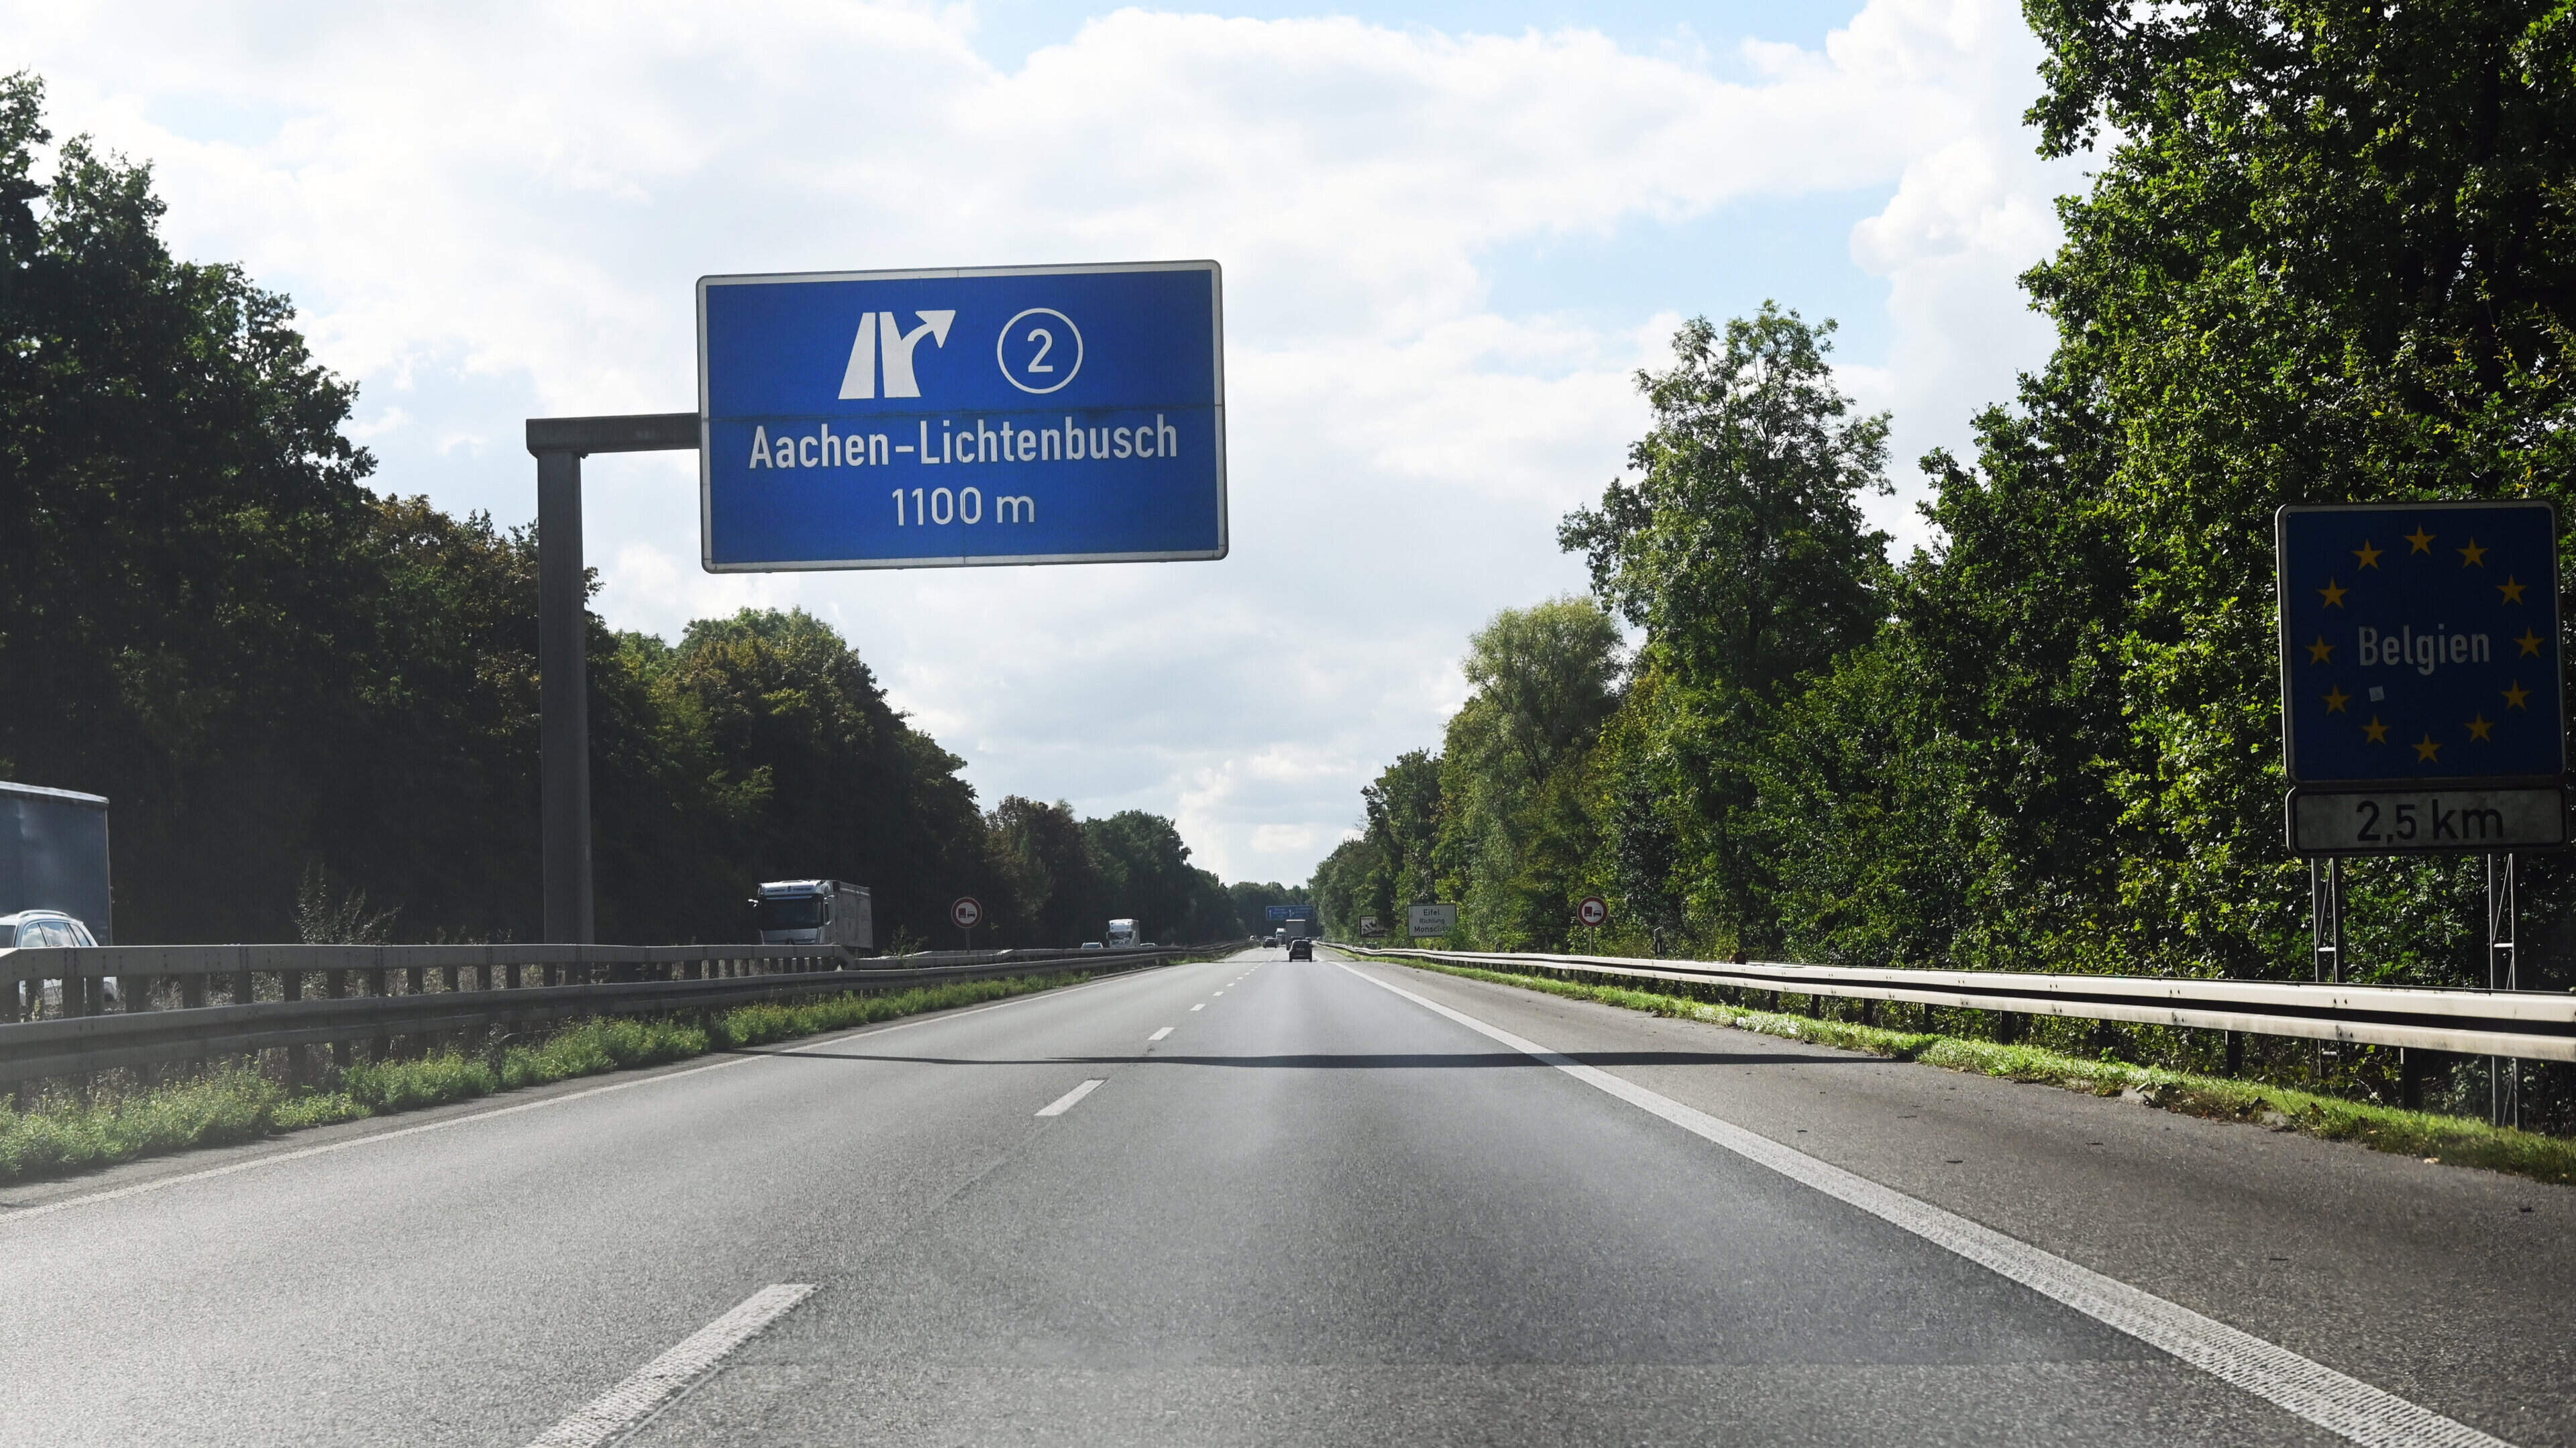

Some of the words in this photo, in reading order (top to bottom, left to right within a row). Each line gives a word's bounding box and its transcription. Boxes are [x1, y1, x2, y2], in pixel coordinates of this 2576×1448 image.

[1027, 329, 1053, 373] 2
[749, 414, 1177, 469] Aachen-Lichtenbusch
[892, 487, 983, 526] 1100
[997, 495, 1034, 523] m
[2359, 624, 2490, 675] Belgien
[2355, 800, 2418, 844] 2,5
[2432, 799, 2504, 840] km
